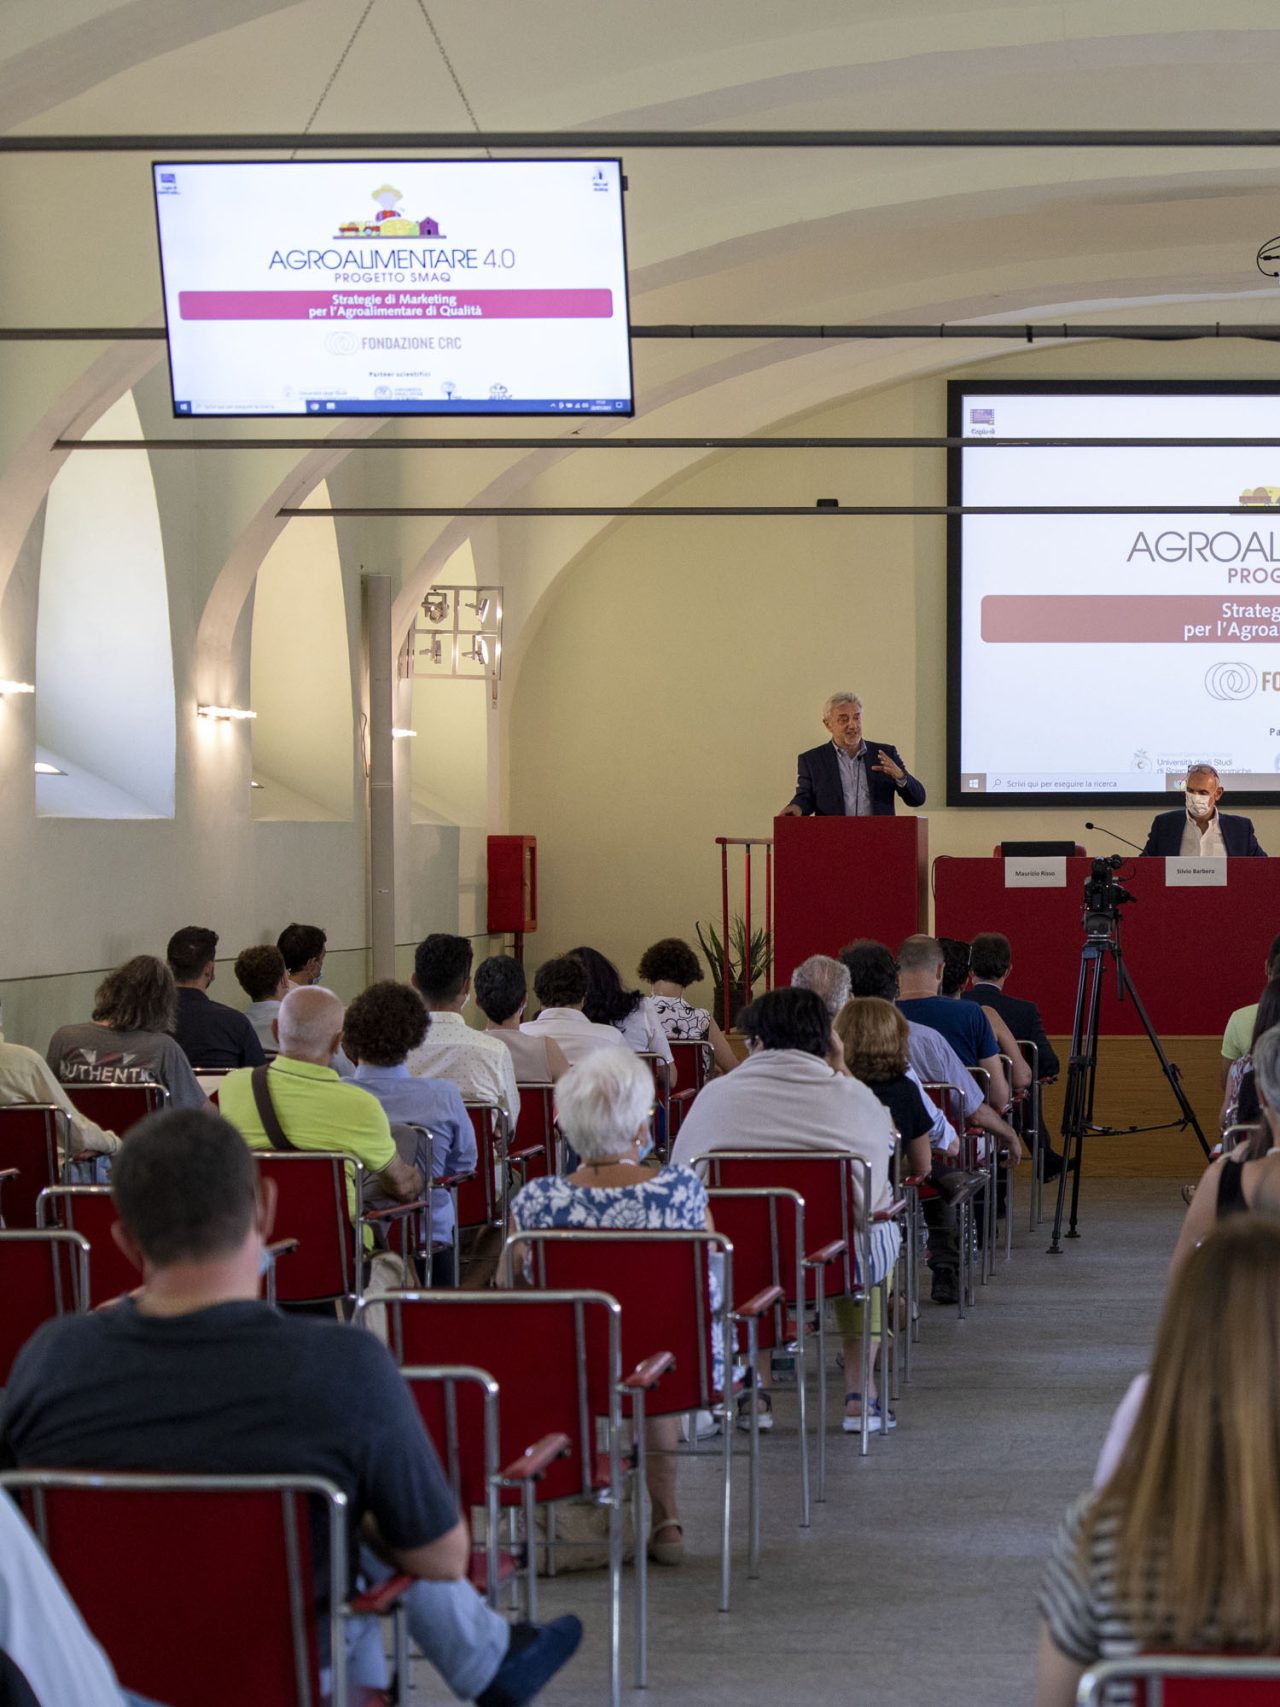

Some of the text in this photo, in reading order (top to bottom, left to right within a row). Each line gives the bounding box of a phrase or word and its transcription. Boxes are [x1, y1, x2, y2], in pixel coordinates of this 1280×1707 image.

[268, 248, 516, 271] AGROALIMENTARE 4.0
[334, 272, 452, 283] PROGETTO SMAQ
[332, 294, 457, 307] Strategie di Marketing
[308, 307, 327, 319] per
[425, 305, 437, 316] di
[439, 305, 483, 316] Qualità
[361, 336, 462, 351] FONDAZIONE CRC
[1183, 623, 1212, 641] per
[1027, 779, 1039, 789] qui
[1040, 780, 1052, 789] per
[1085, 779, 1093, 788] la
